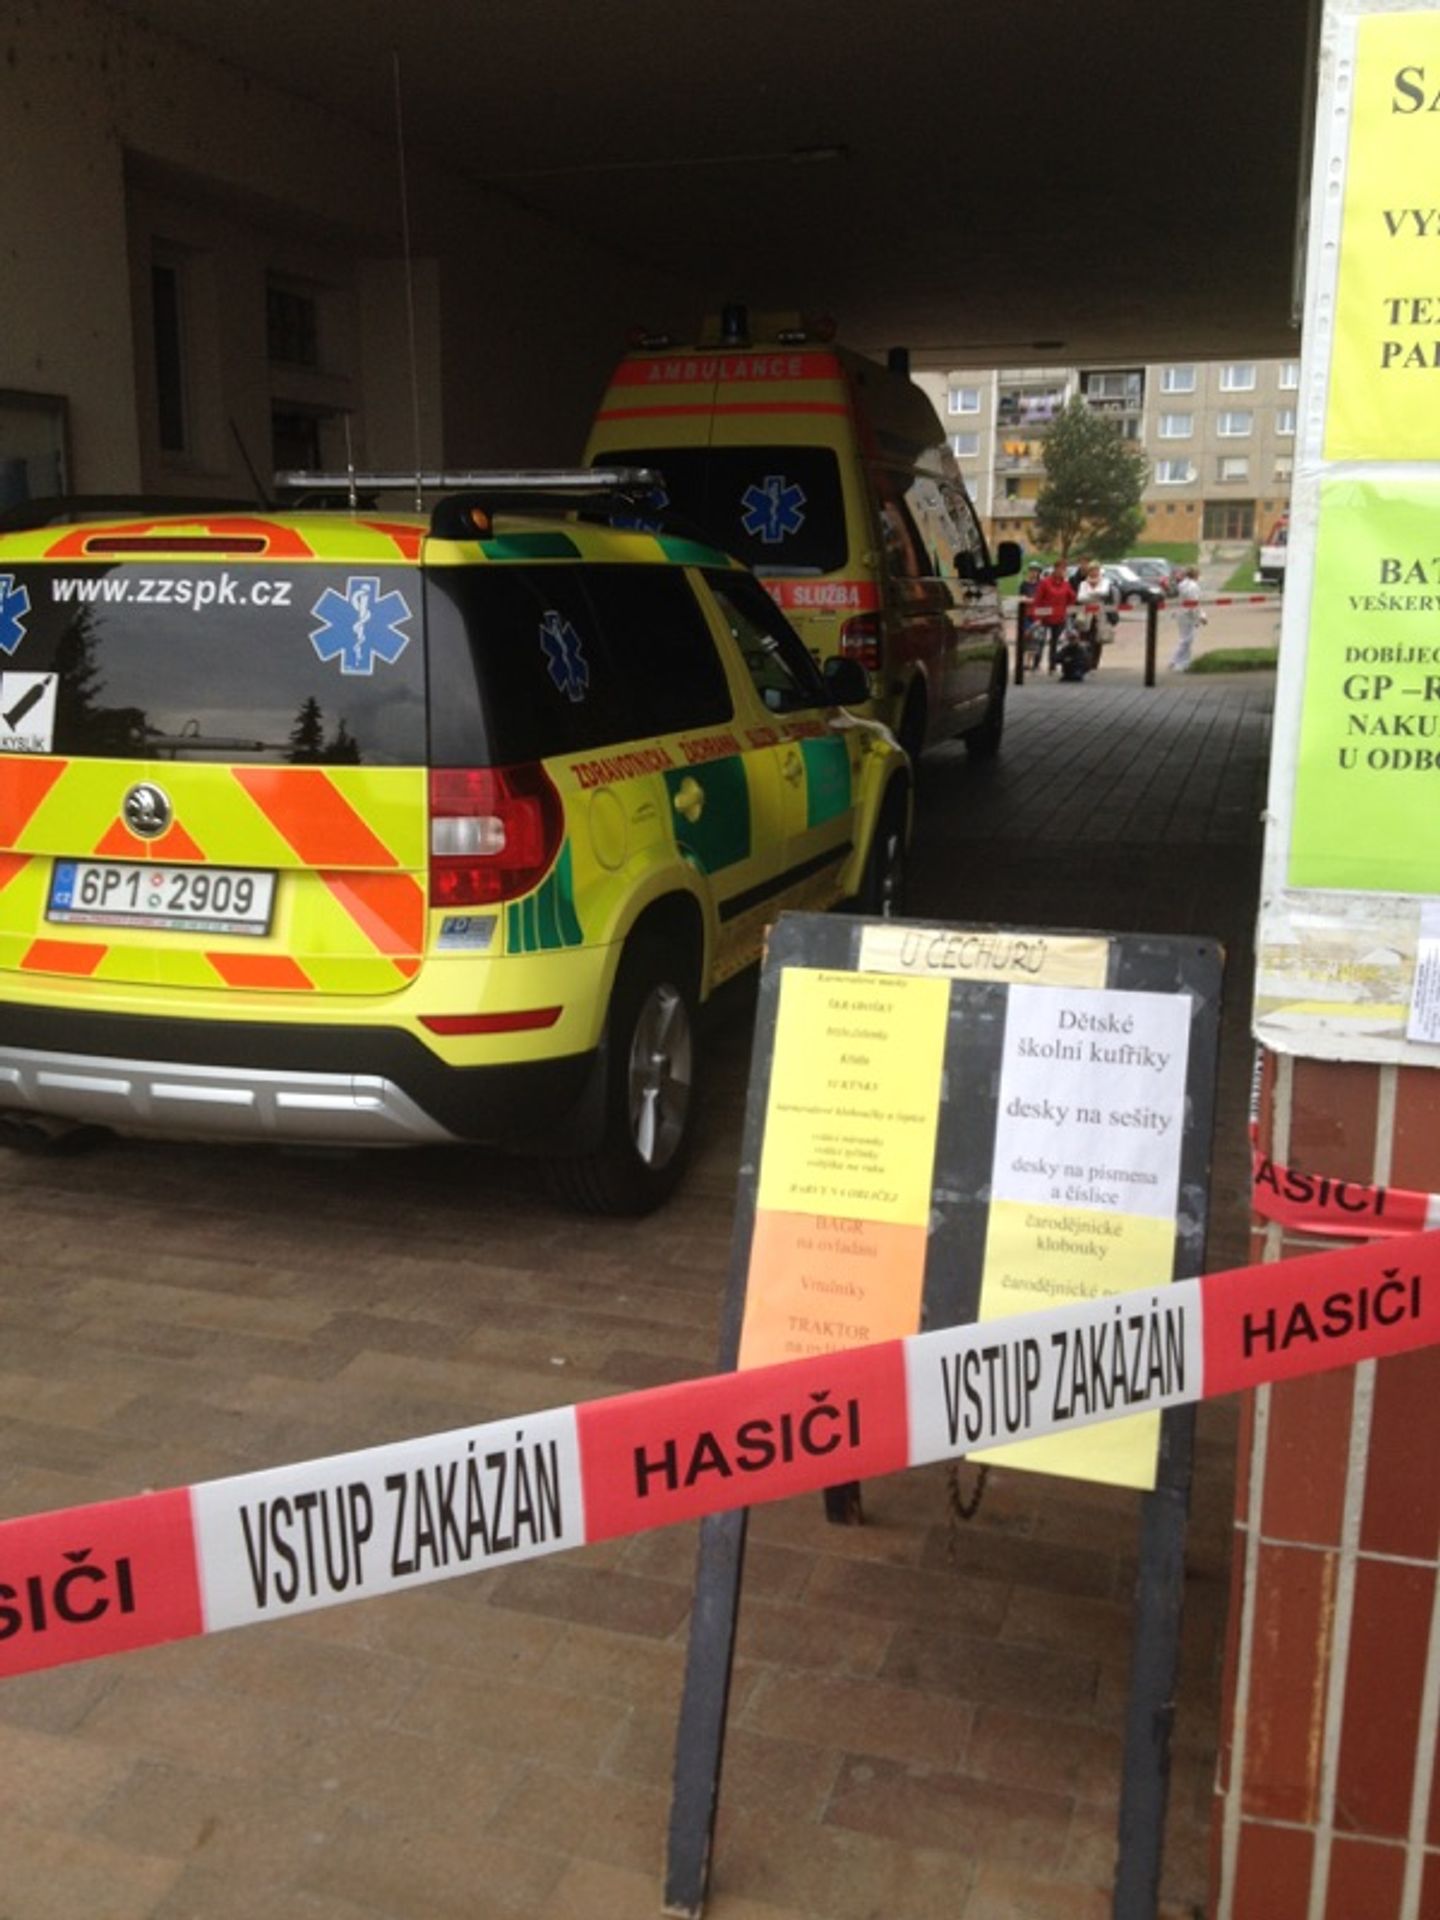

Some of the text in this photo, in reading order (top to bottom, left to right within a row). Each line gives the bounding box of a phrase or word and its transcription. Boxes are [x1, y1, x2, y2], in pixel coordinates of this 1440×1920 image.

[1383, 208, 1440, 236] VY
[1383, 297, 1440, 325] TE
[648, 357, 802, 381] AMBULANCE
[52, 572, 292, 611] www.zzspk.cz
[793, 584, 860, 607] SLUŽBA
[1343, 674, 1393, 700] GP
[1338, 747, 1440, 770] U ODB
[81, 868, 254, 914] 6P1 2909
[1058, 1009, 1134, 1034] Dětské
[1017, 1038, 1083, 1061] školní
[1006, 1097, 1173, 1136] desky na sešity
[1011, 1157, 1057, 1179] desky
[1063, 1162, 1084, 1177] na
[1050, 1189, 1060, 1200] a
[1036, 1235, 1109, 1261] klobouky
[787, 1315, 870, 1341] TRAKTOR
[240, 1481, 374, 1608] VSTUP
[385, 1430, 563, 1578] ZAKÁZÁN
[633, 1390, 861, 1498] HASIČI
[941, 1338, 1042, 1447] VSTUP
[1051, 1296, 1185, 1422] ZAKÁZÁN
[1242, 1267, 1422, 1358] HASIČI
